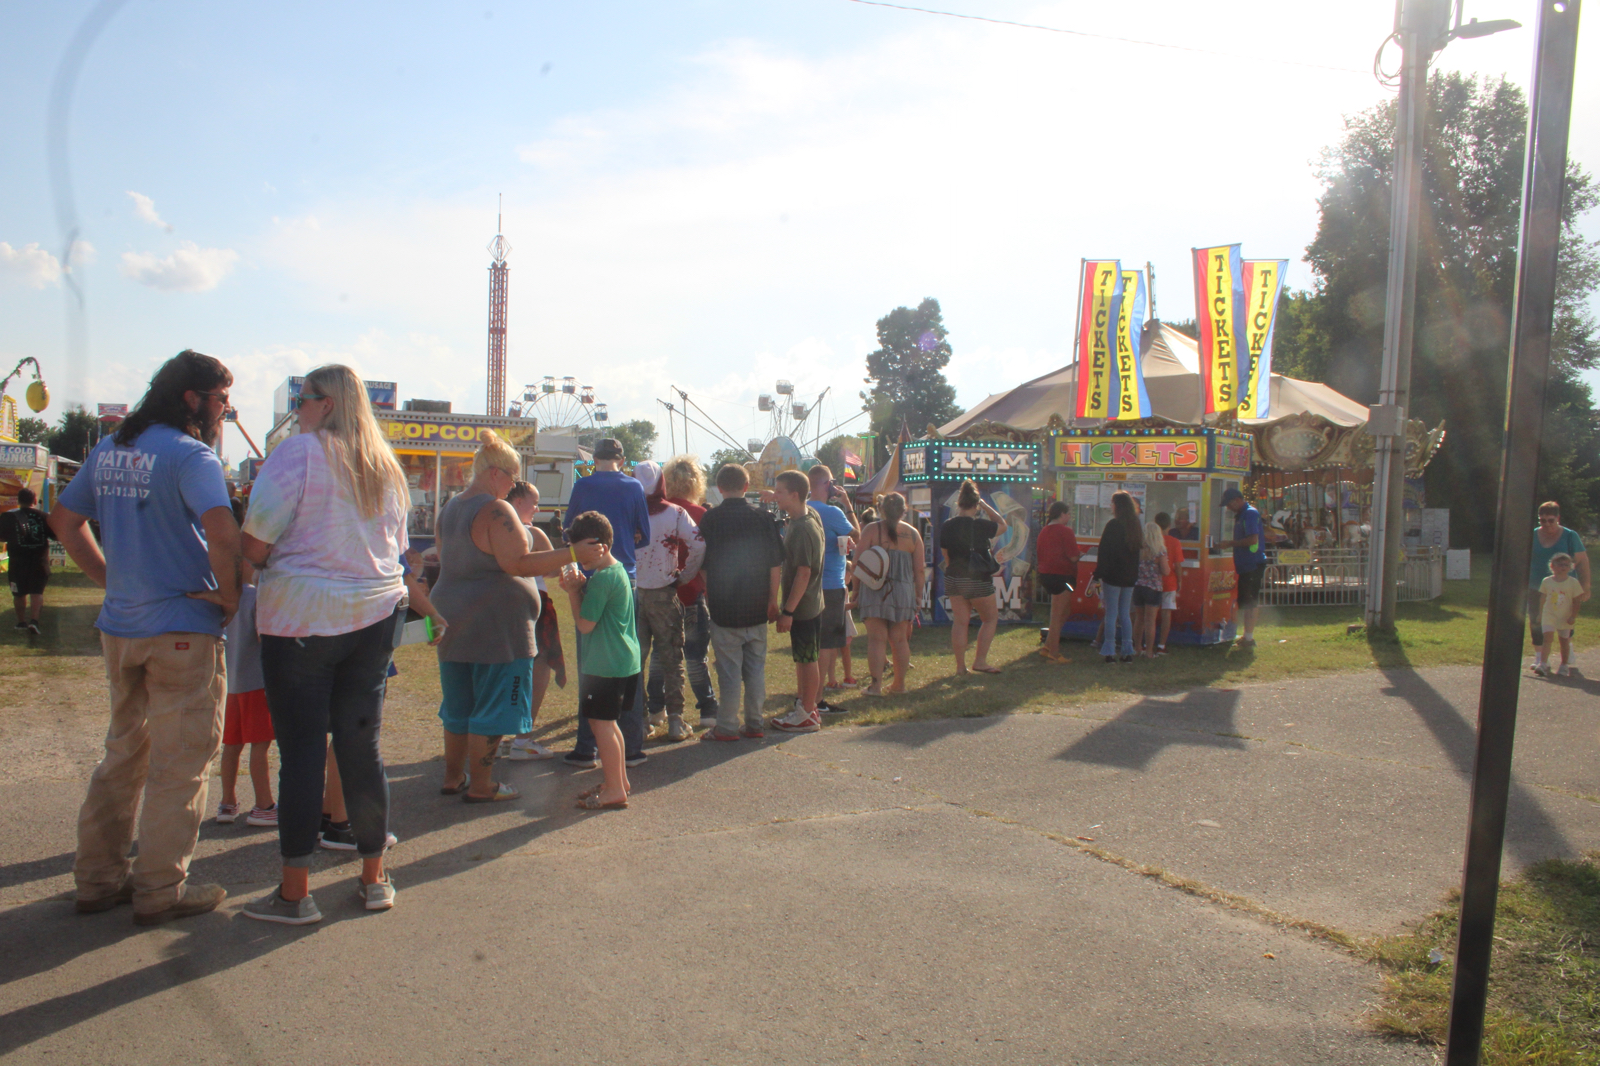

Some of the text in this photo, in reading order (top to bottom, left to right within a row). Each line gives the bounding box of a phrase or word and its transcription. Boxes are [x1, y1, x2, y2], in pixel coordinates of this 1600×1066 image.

[1090, 270, 1112, 410] TICKETS
[1214, 254, 1232, 402] TICKETS
[1241, 270, 1271, 411] TICKES
[364, 381, 392, 390] AUSAGE
[8, 446, 33, 455] COLD
[905, 452, 924, 470] ATM
[945, 452, 1029, 470] ATM
[1060, 441, 1198, 466] TICKETS
[1216, 442, 1249, 469] TICKETS
